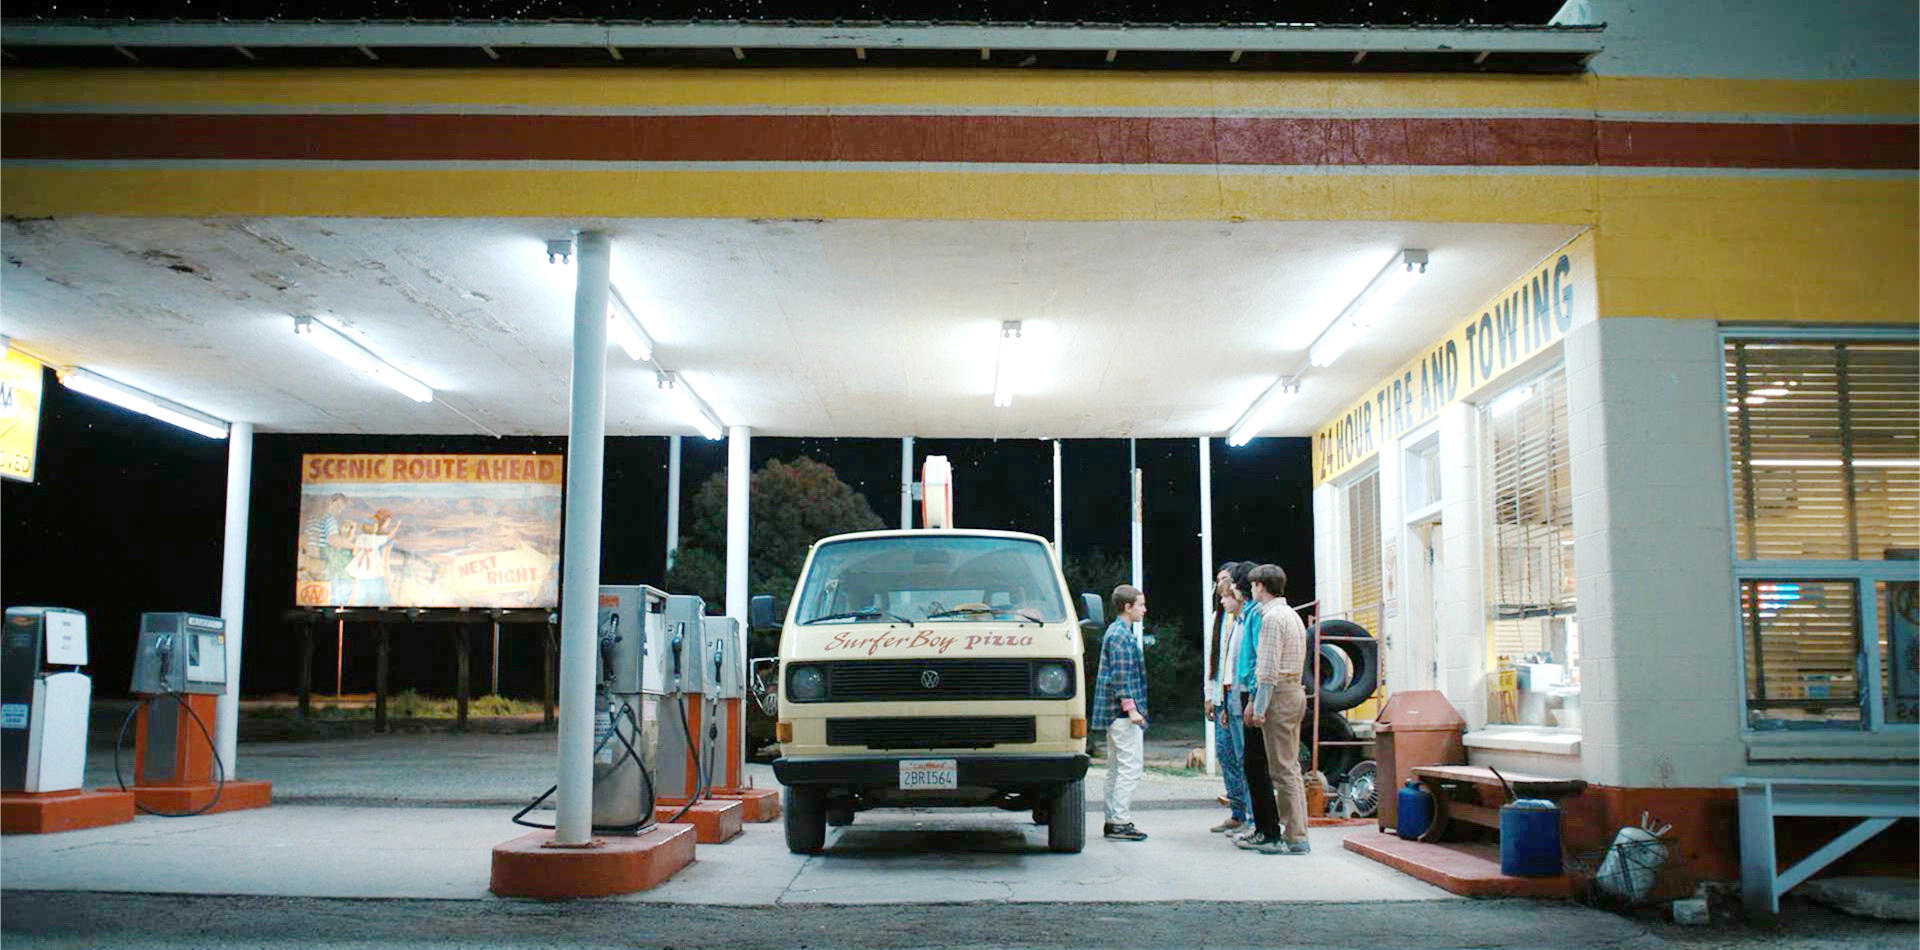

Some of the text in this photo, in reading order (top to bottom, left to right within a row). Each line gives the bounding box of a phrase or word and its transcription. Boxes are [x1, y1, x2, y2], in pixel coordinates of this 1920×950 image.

[1319, 254, 1574, 480] 24 HOUR TIRE AND TOWING
[308, 457, 555, 481] SCENIC ROUTE AHEAD
[458, 555, 498, 577] NEXT
[487, 567, 538, 585] RIGHT
[964, 631, 1034, 650] pizza
[904, 770, 952, 785] 2BRI564
